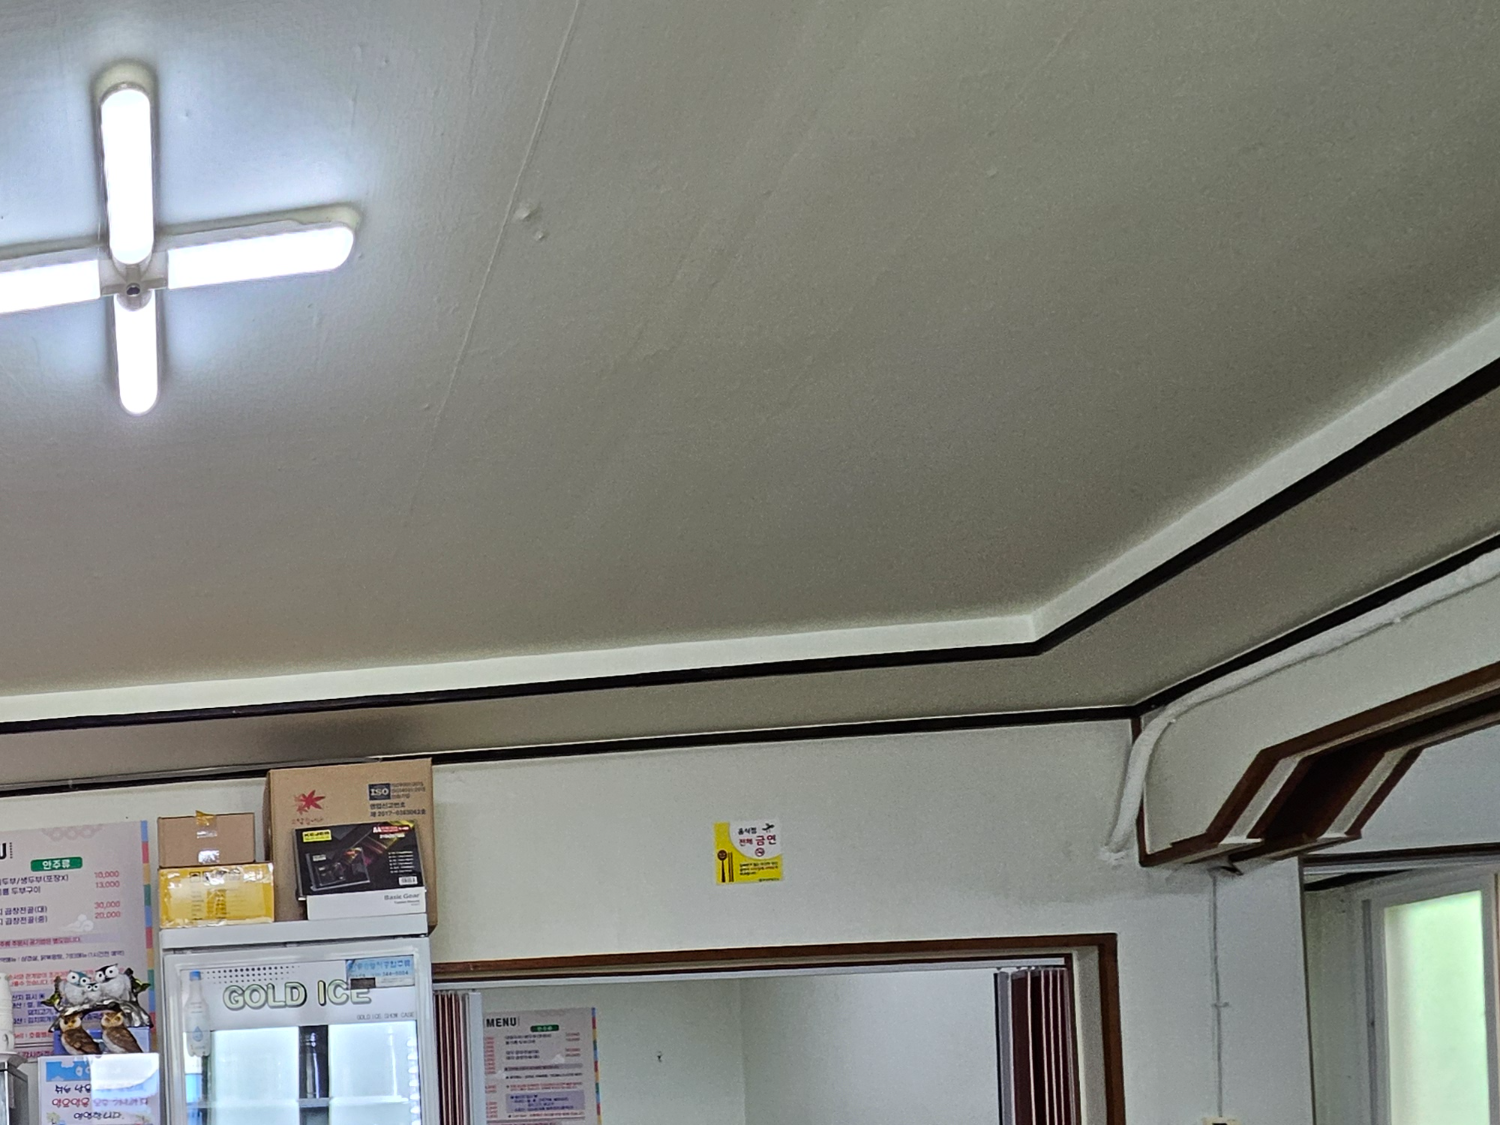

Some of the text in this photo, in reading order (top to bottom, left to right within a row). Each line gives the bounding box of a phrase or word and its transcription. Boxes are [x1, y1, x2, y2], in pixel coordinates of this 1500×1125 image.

[756, 835, 776, 846] 금연
[42, 860, 71, 870] 안주류
[223, 979, 372, 1011] GOLD ICE
[486, 1017, 517, 1028] MENU
